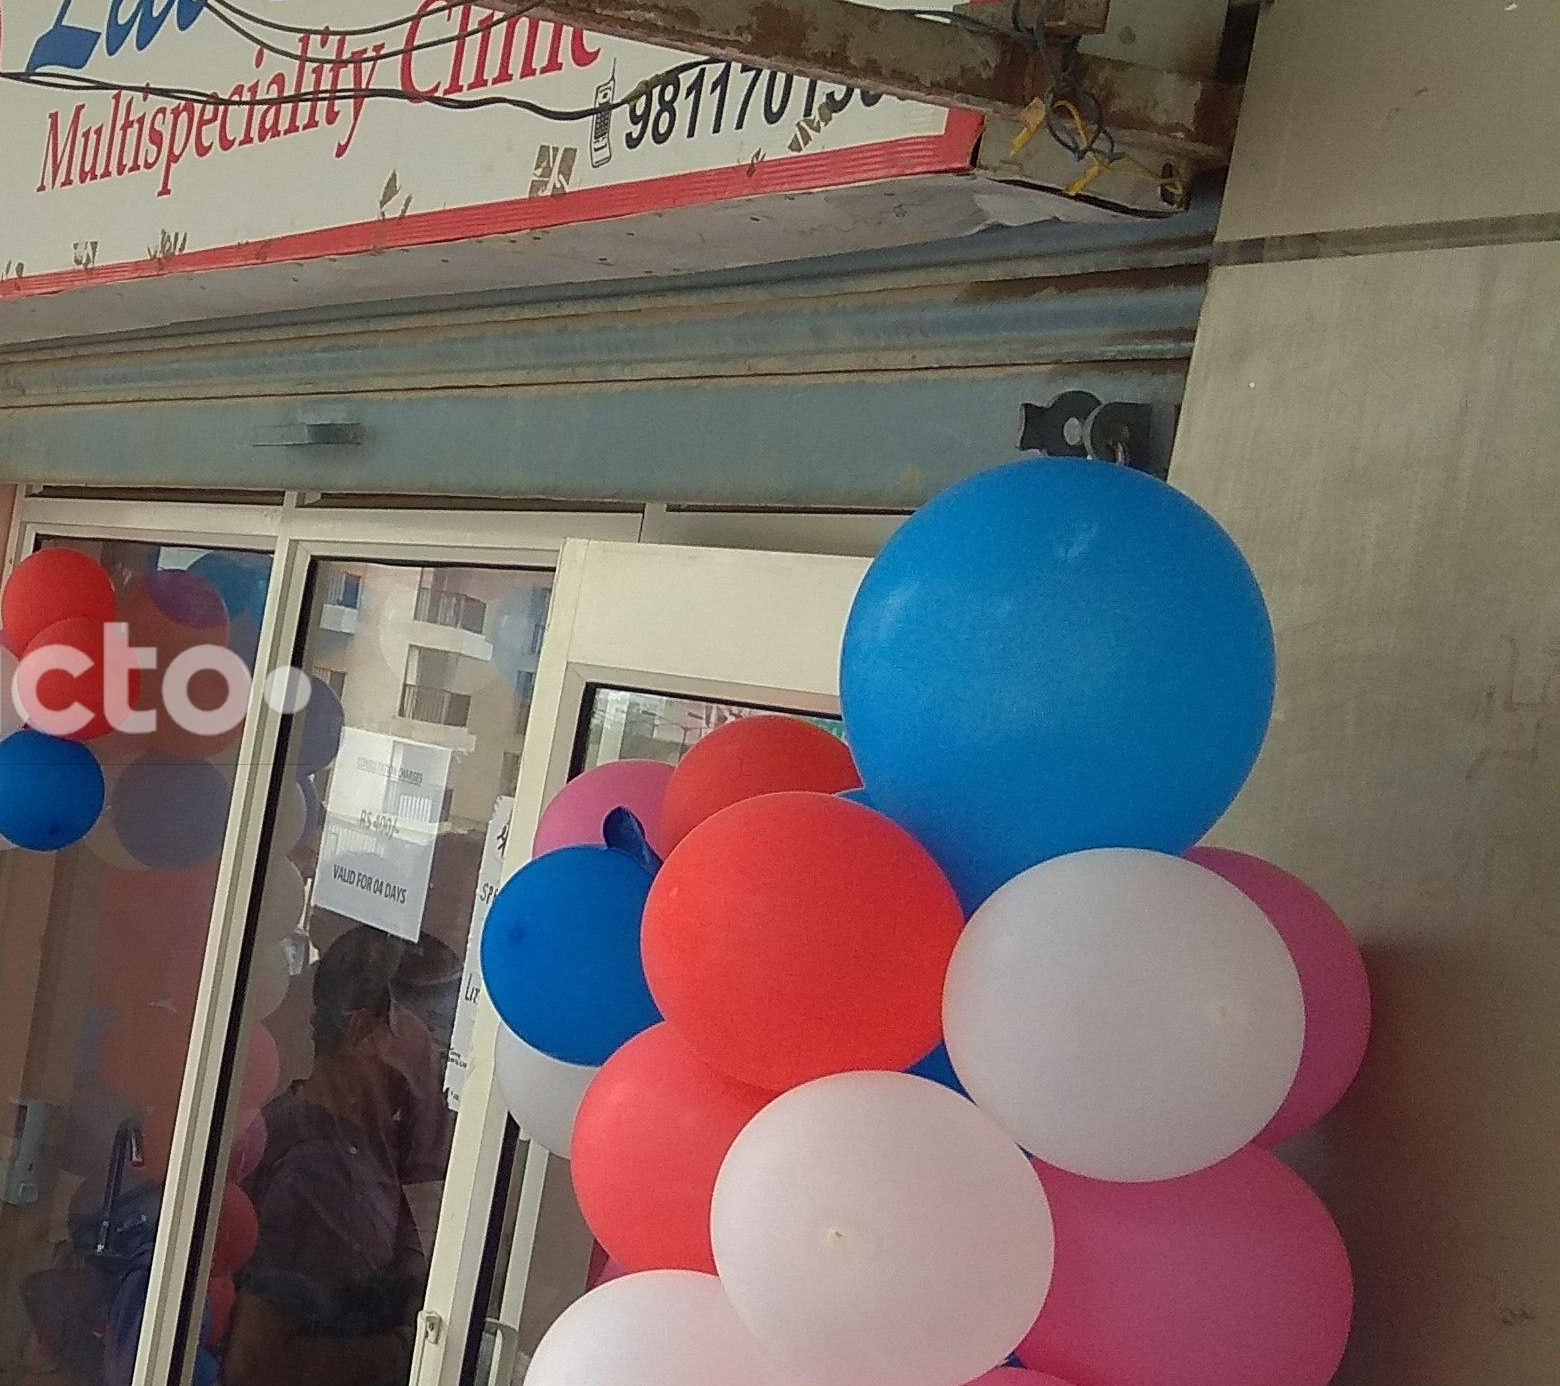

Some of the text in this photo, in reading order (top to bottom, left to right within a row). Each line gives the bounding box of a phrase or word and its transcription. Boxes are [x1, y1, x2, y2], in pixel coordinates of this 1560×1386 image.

[36, 24, 386, 199] Multispeciality
[333, 863, 407, 905] VALID FOR 04 DAYS
